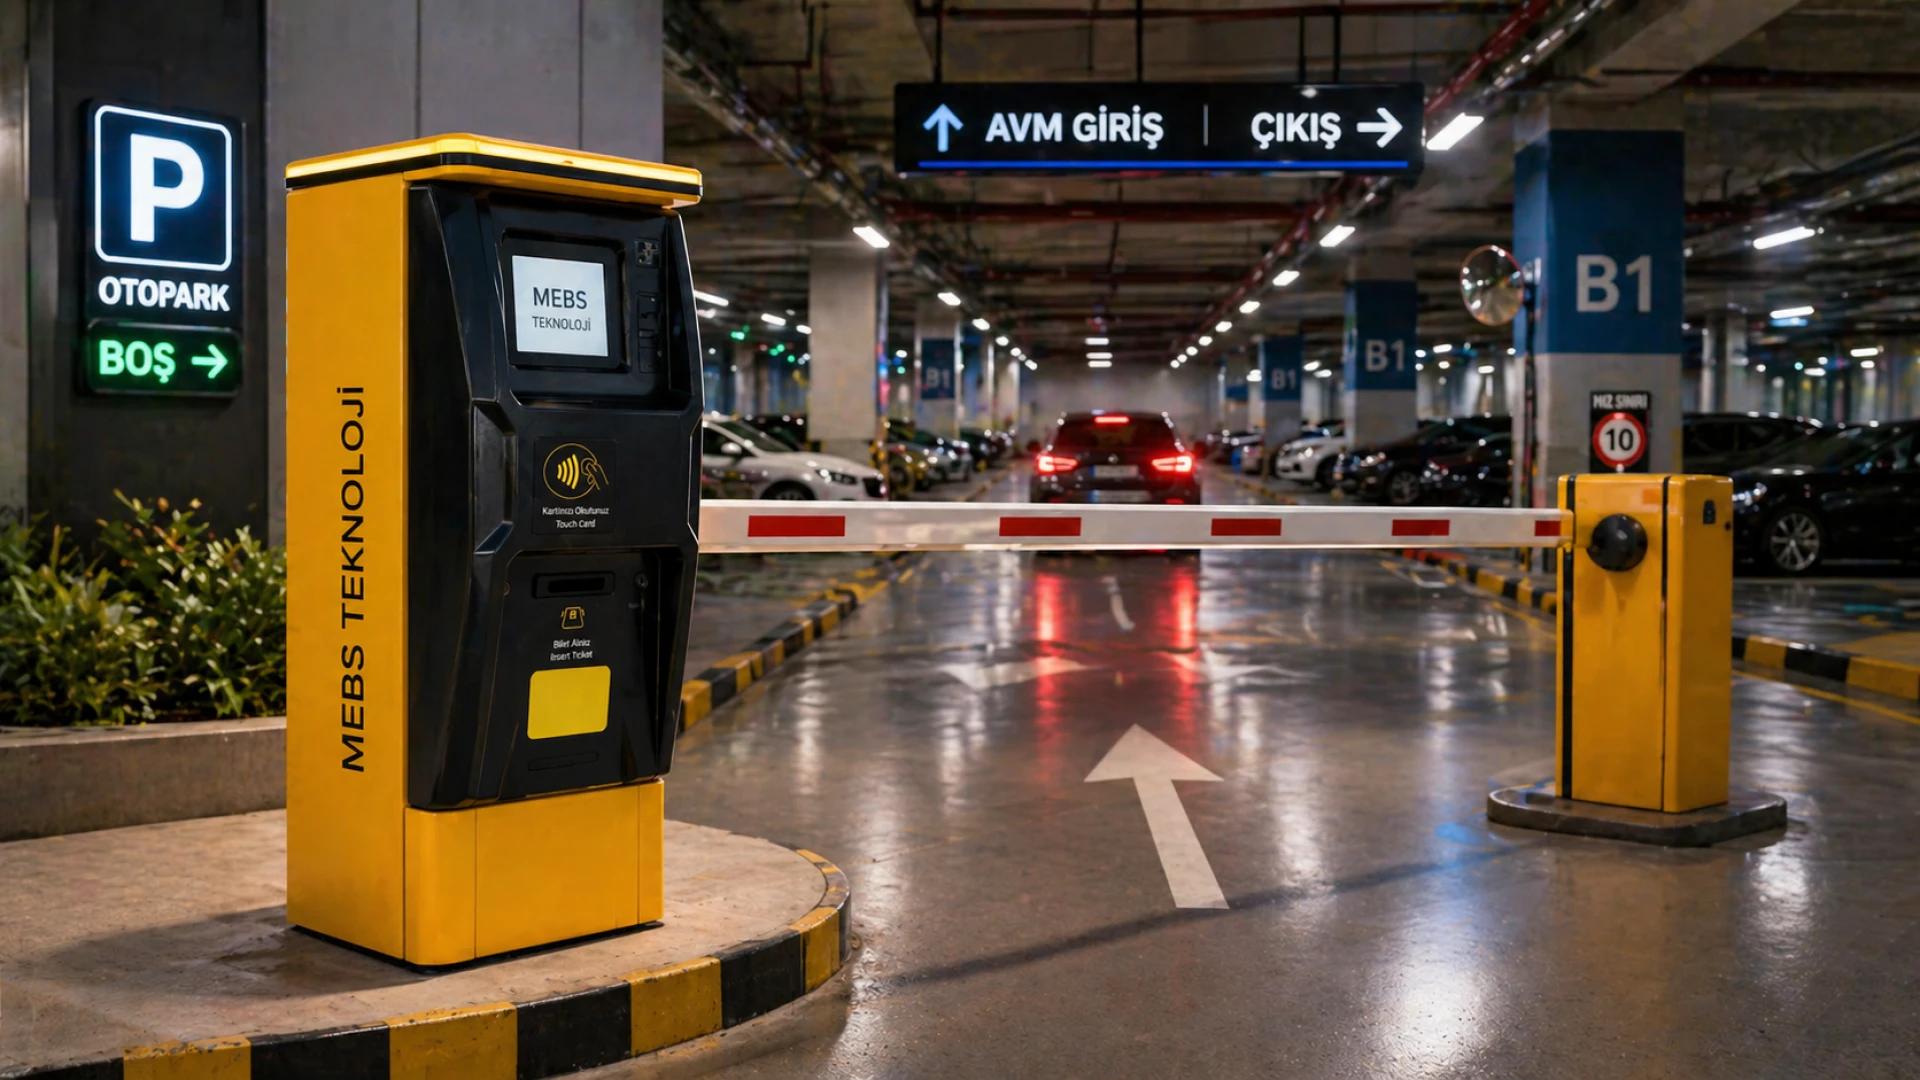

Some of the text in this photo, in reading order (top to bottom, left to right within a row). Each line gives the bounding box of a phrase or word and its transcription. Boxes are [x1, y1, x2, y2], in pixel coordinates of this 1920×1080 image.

[985, 105, 1164, 150] AVM GİRİŞ
[1250, 112, 1342, 150] ÇIKIŞ
[130, 133, 205, 242] P
[98, 276, 231, 312] OTOPARK
[533, 286, 588, 310] MEBS
[1576, 254, 1652, 313] B1
[532, 315, 591, 332] TEKNOLOJİ
[99, 339, 176, 384] BOŞ
[1364, 339, 1405, 372] B1
[1271, 369, 1297, 390] B1
[1605, 428, 1634, 451] 10
[556, 519, 578, 528] Touch
[336, 386, 365, 773] MEBS TEKNOLOJİ
